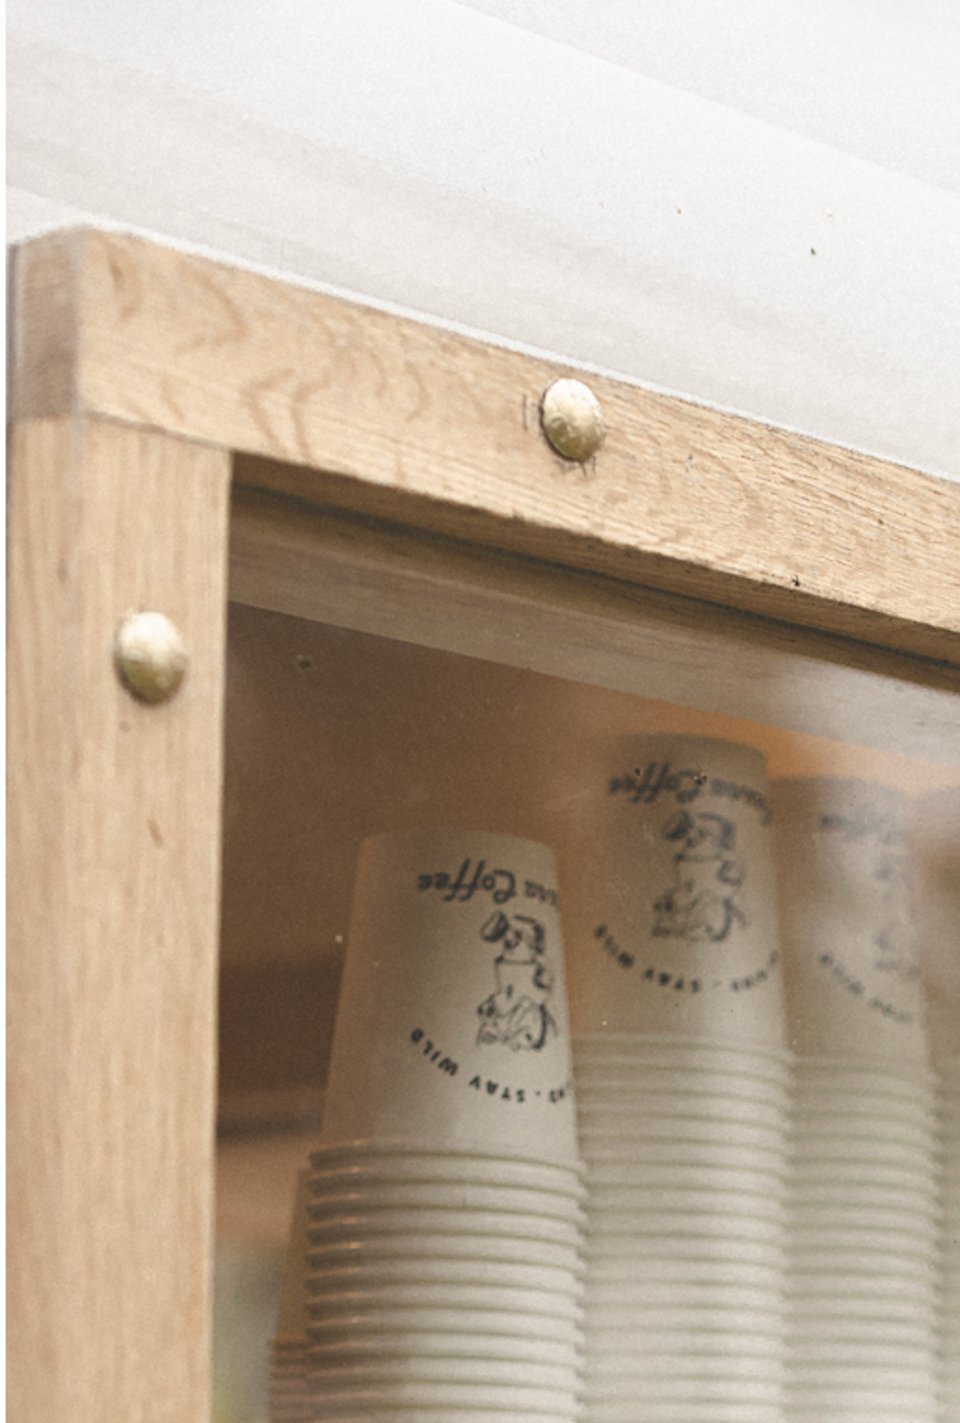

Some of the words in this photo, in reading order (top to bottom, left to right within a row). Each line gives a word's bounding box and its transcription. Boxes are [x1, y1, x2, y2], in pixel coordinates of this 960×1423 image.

[415, 859, 517, 905] Coffee
[410, 1027, 459, 1076] WILD
[468, 1075, 526, 1104] STAY
